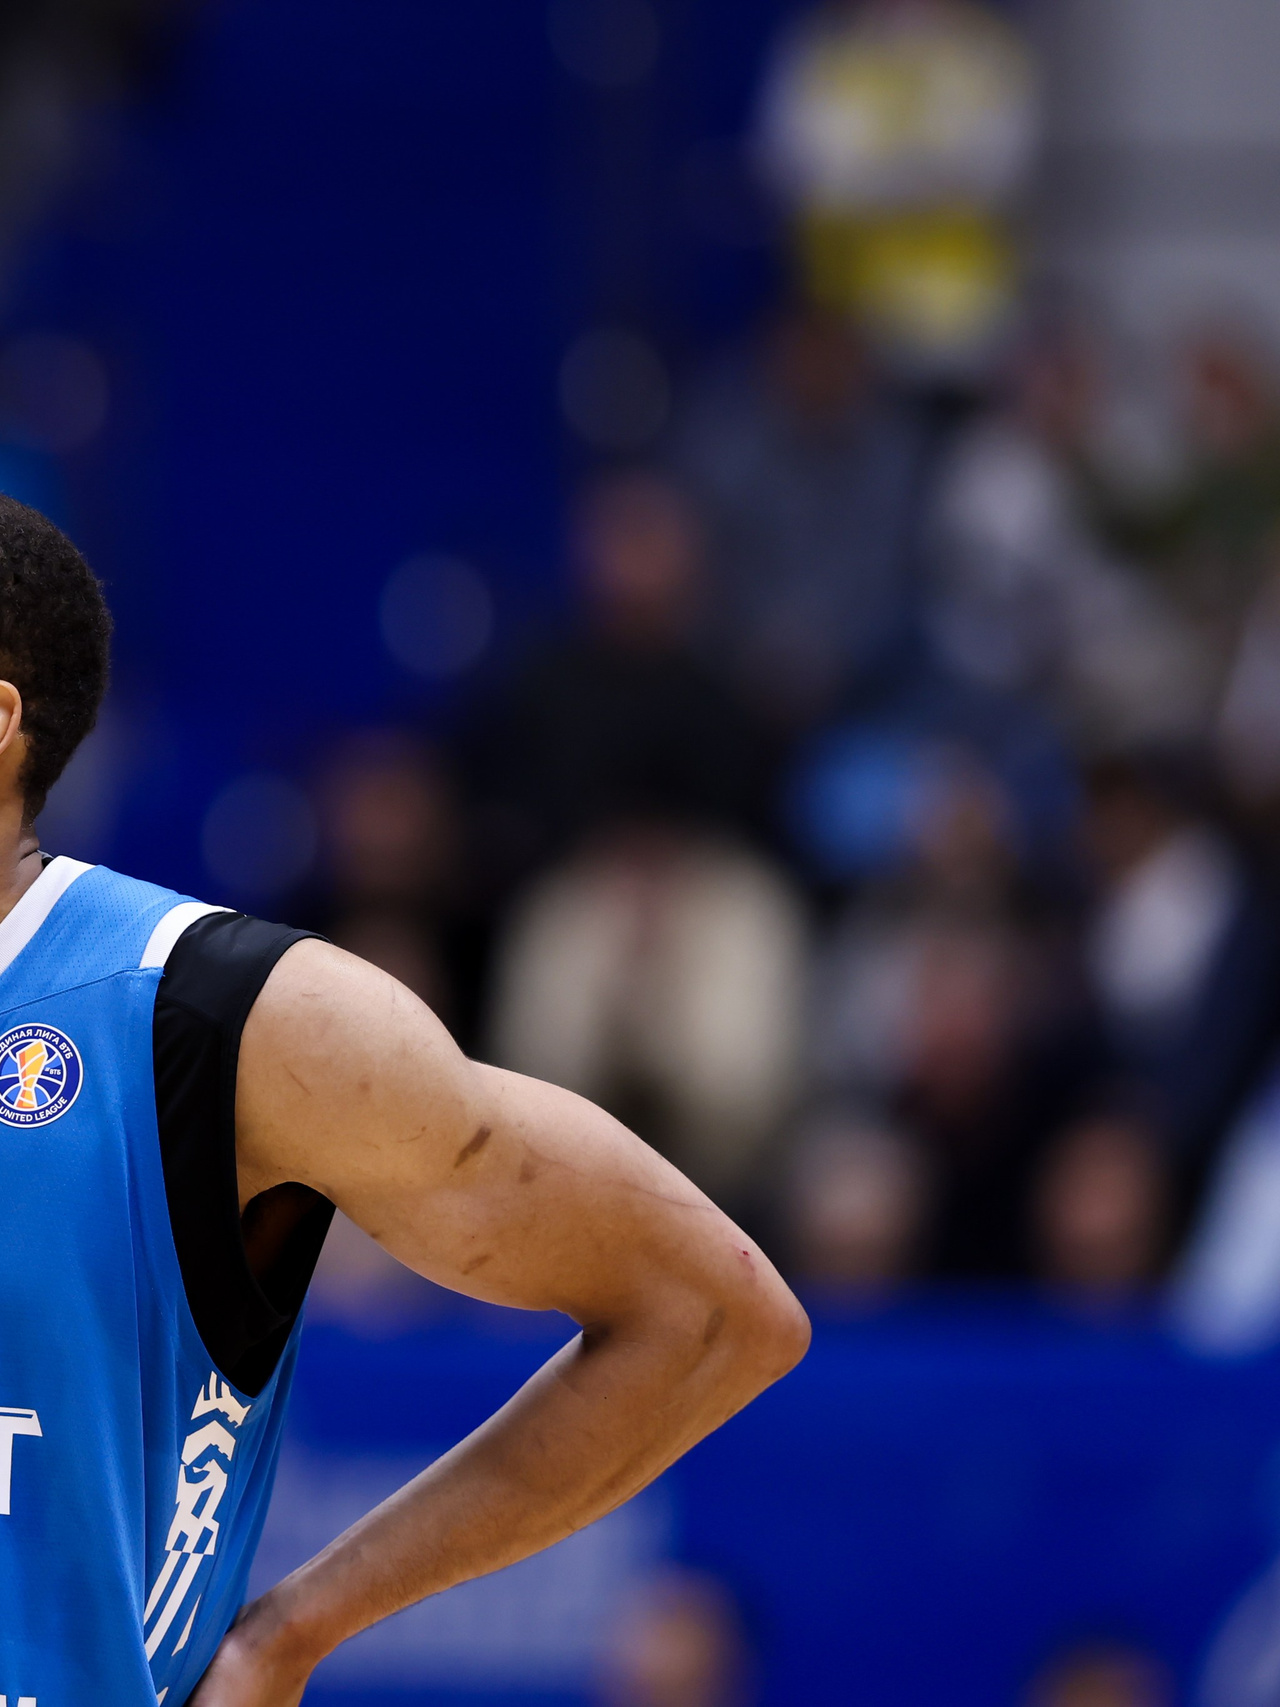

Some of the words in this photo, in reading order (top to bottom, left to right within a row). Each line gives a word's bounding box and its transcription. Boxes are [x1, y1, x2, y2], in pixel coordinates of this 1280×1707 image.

[34, 1028, 60, 1045] ЛИГА
[59, 1042, 74, 1060] ВТБ
[34, 1096, 68, 1121] LEAGUE
